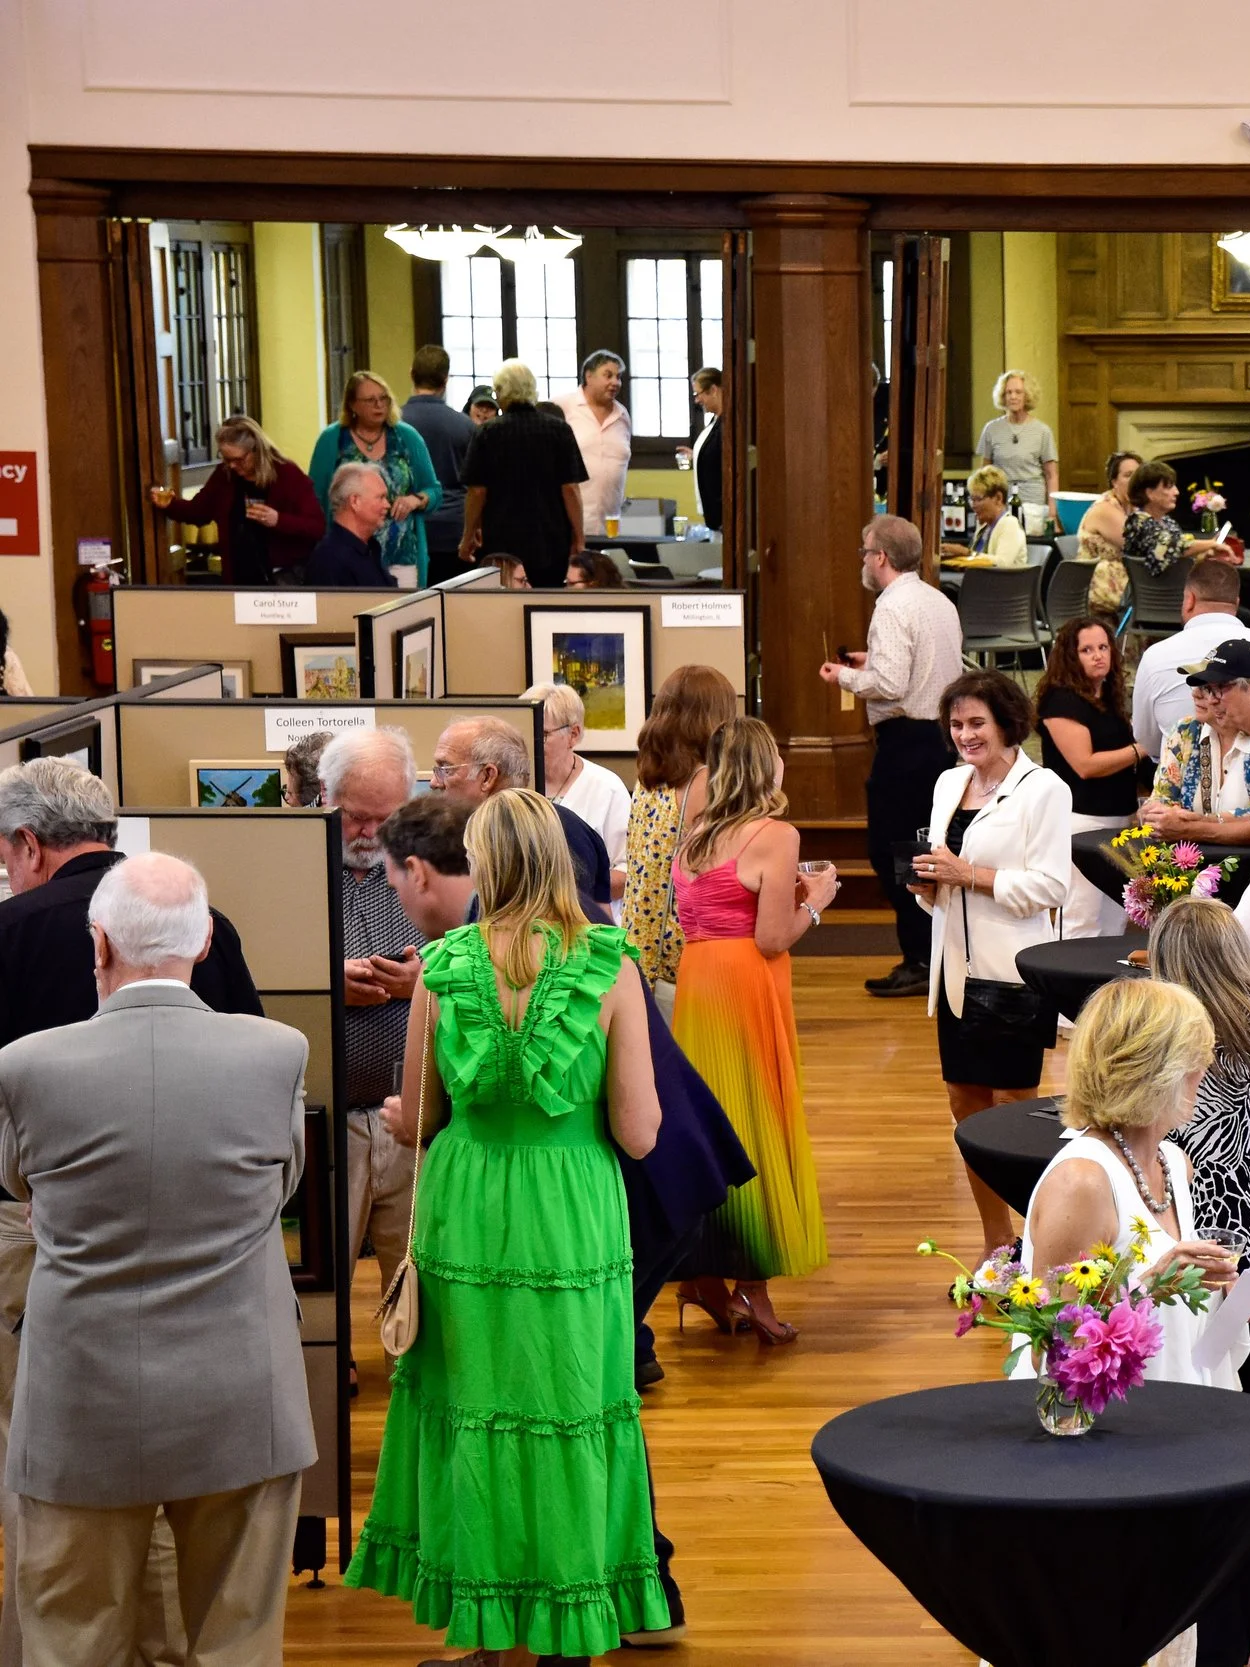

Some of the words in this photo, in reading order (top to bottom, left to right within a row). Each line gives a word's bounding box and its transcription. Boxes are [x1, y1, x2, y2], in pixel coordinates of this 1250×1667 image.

[0, 464, 28, 483] cy
[253, 599, 275, 608] Carol
[277, 599, 299, 608] Sturz
[671, 602, 699, 610] Robert
[701, 602, 732, 610] Holmes
[276, 718, 314, 727] Colleen
[317, 717, 366, 727] Tortorella
